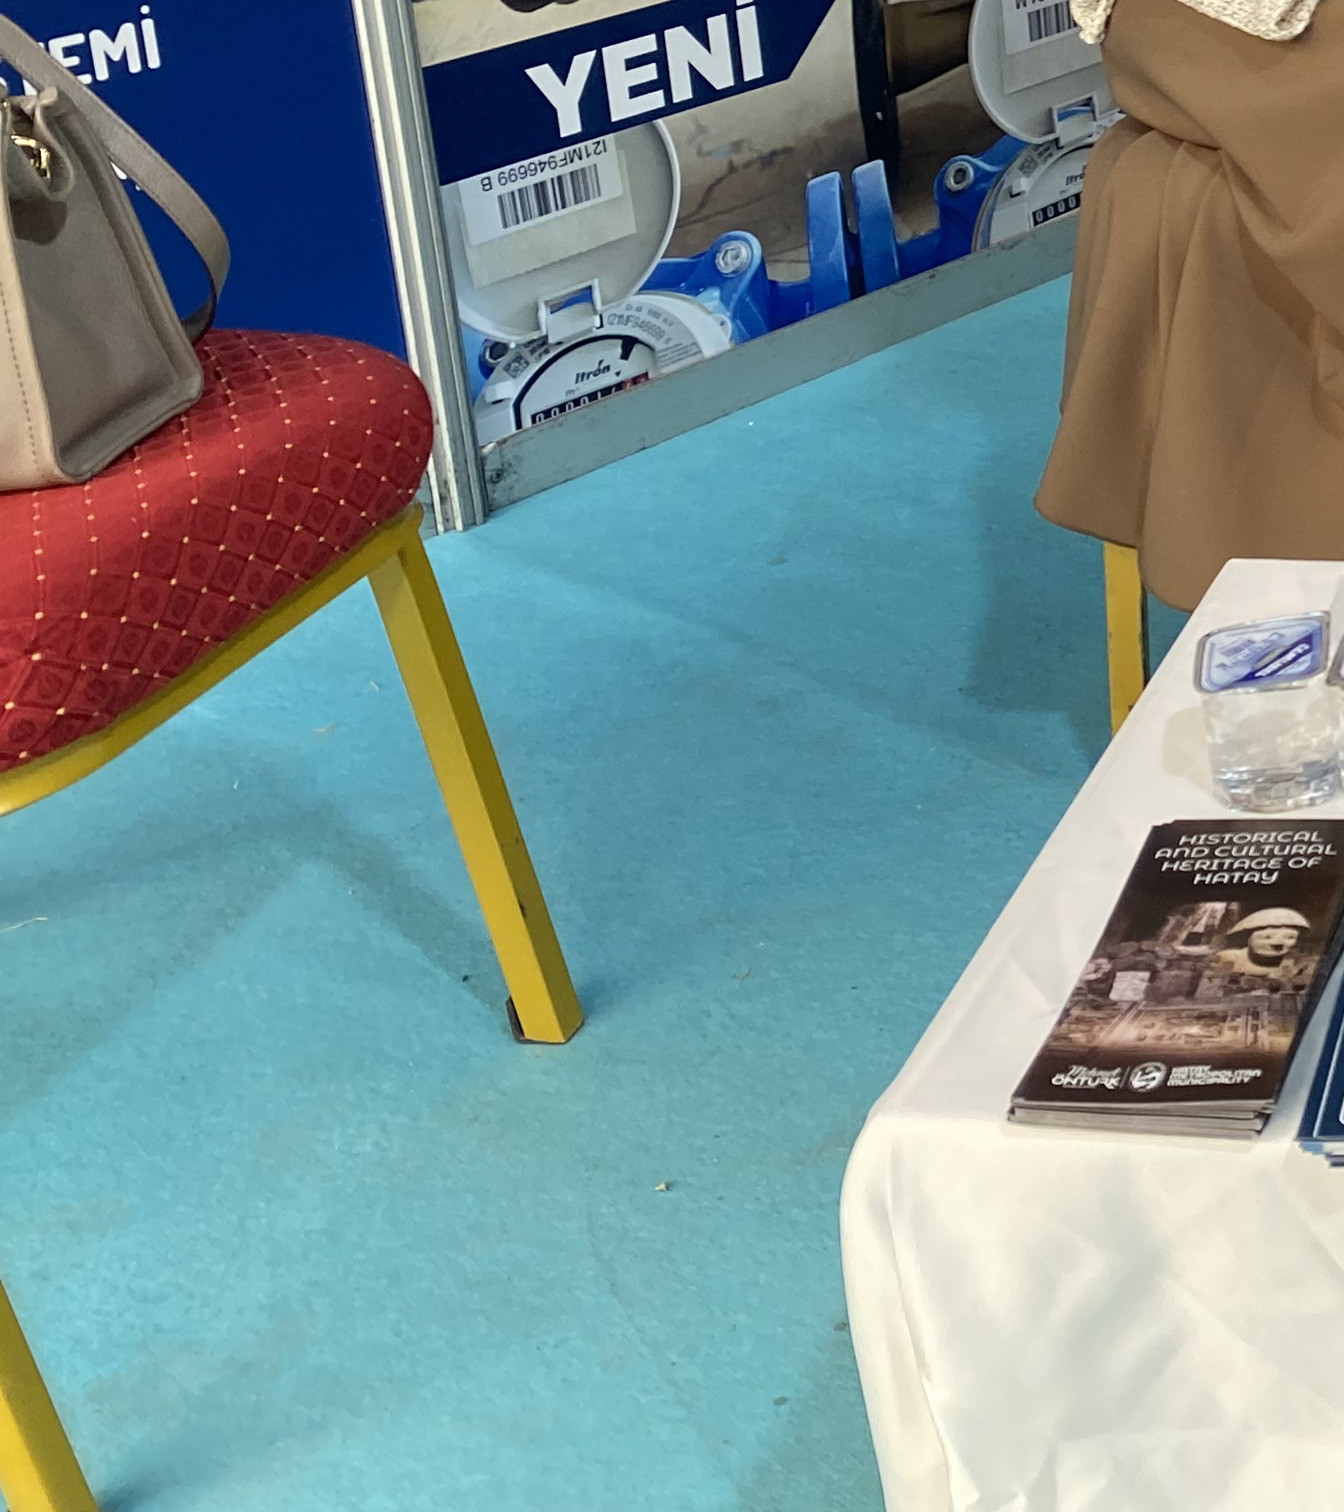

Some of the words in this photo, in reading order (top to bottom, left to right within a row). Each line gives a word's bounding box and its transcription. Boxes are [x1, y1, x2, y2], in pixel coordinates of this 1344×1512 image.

[481, 176, 493, 192] B
[1179, 830, 1325, 845] HISTORICAL
[1155, 846, 1207, 859] AND
[1213, 843, 1338, 858] CULTURAL
[1161, 857, 1282, 872] HERITAGE
[1288, 856, 1323, 870] OF
[1193, 870, 1280, 886] HATAY
